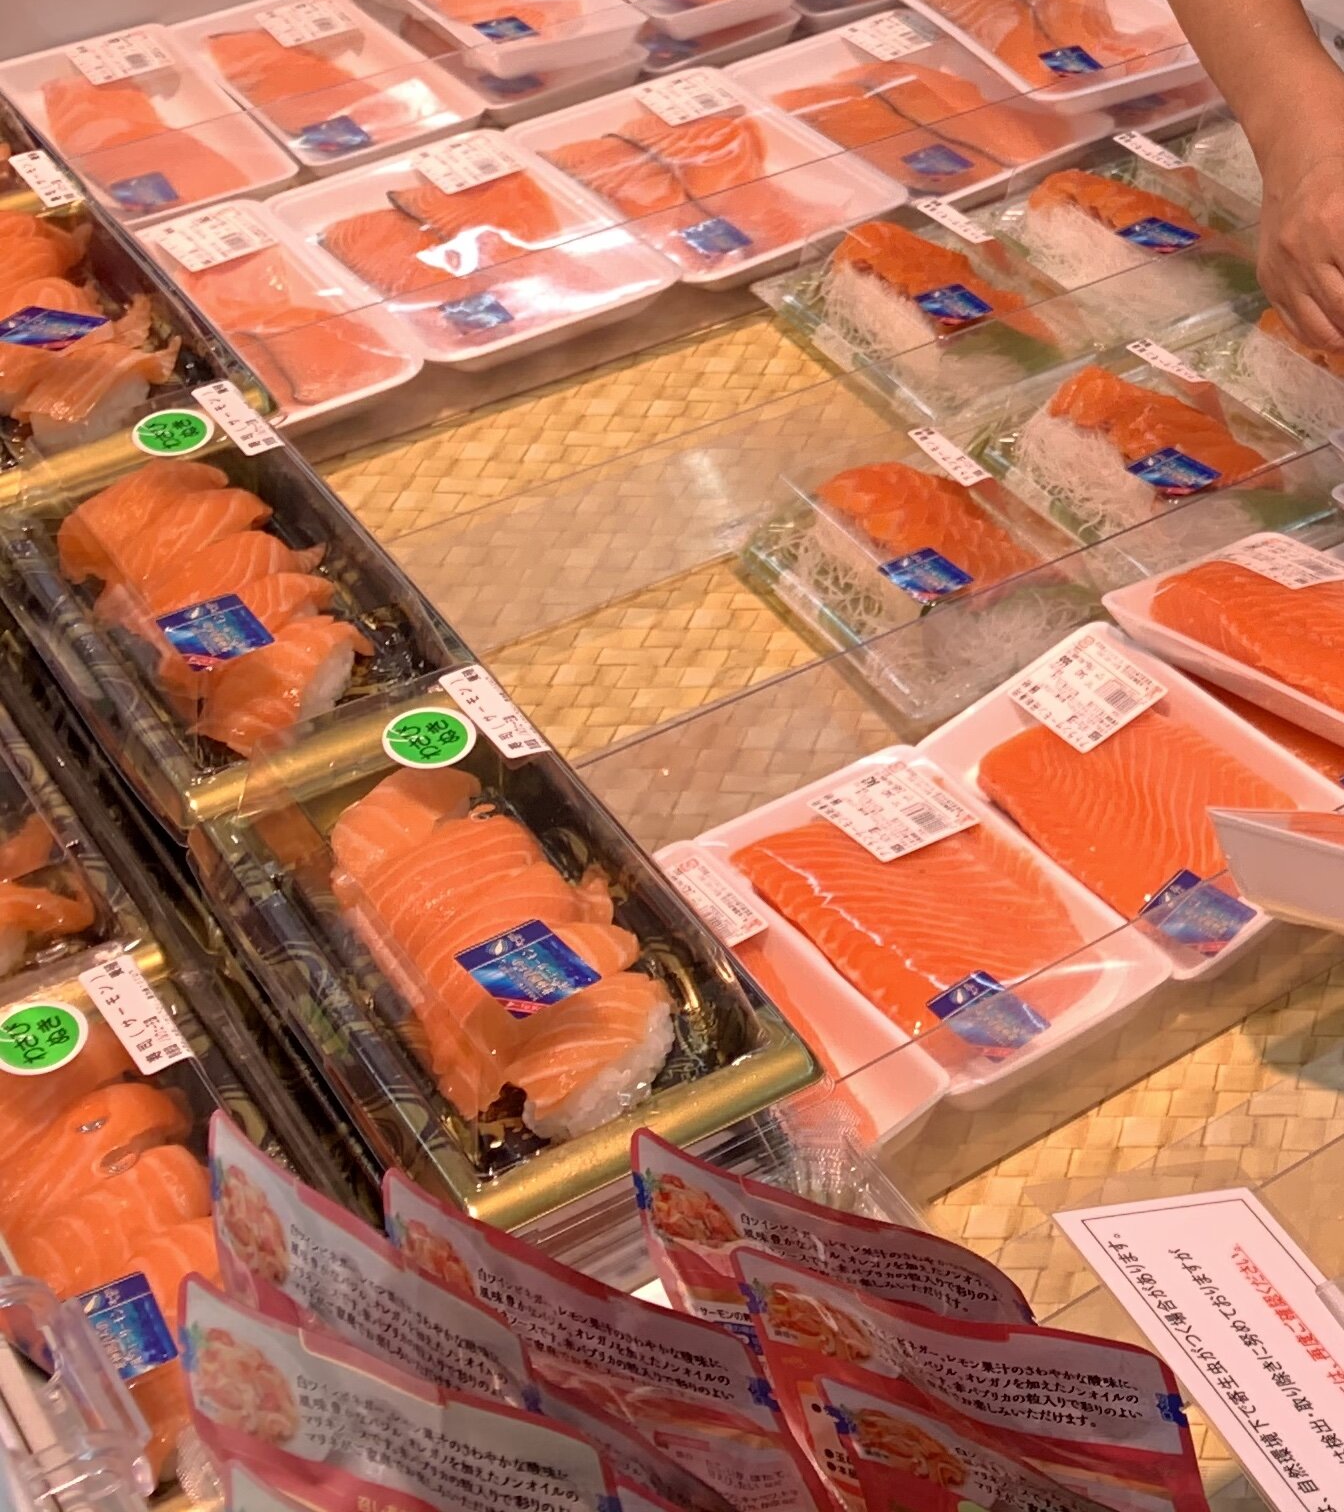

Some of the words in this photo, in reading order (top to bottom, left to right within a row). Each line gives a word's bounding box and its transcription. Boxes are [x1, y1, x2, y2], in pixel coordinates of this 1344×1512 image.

[895, 1336, 1139, 1393] ビネガー、レモン果汁のさわやかな酸味に、
